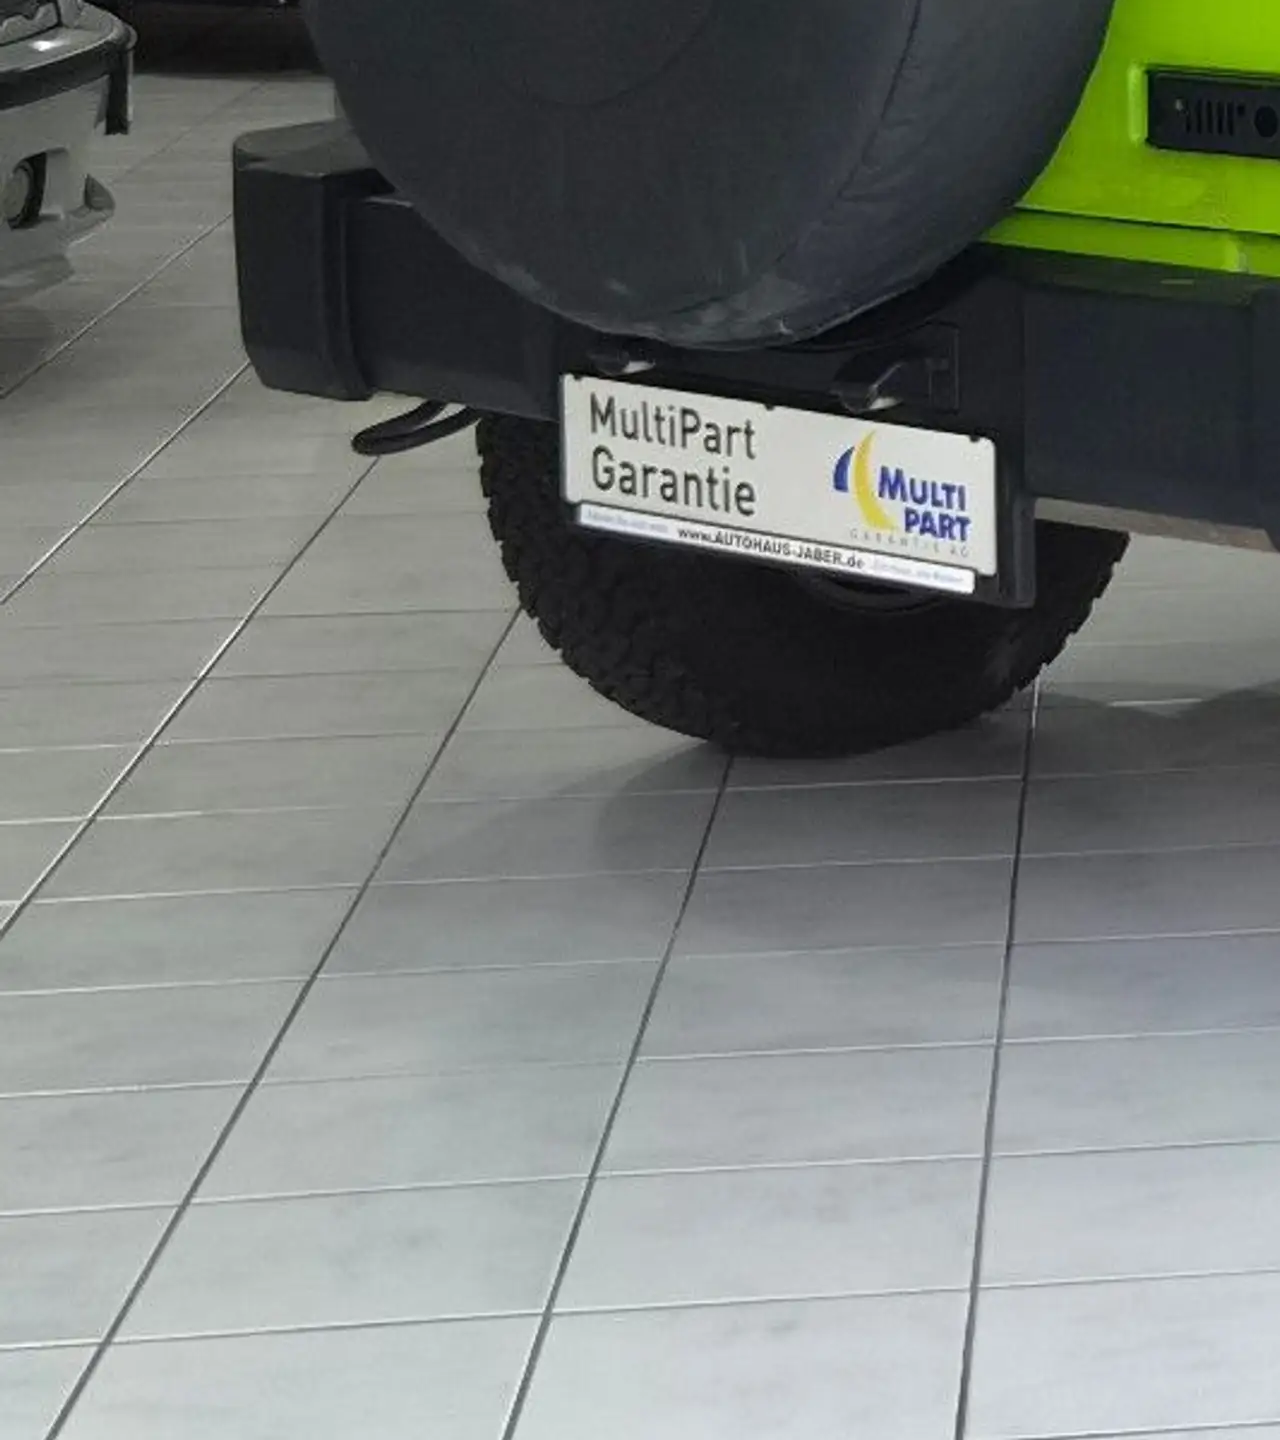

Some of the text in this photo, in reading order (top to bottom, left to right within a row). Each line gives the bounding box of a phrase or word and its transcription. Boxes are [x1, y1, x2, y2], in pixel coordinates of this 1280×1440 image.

[589, 391, 757, 461] MultiPart
[591, 447, 757, 518] Garantie
[877, 465, 967, 512] MULTI
[676, 527, 866, 570] www.AUTOHAUS-JABER.de
[903, 507, 972, 543] PART
